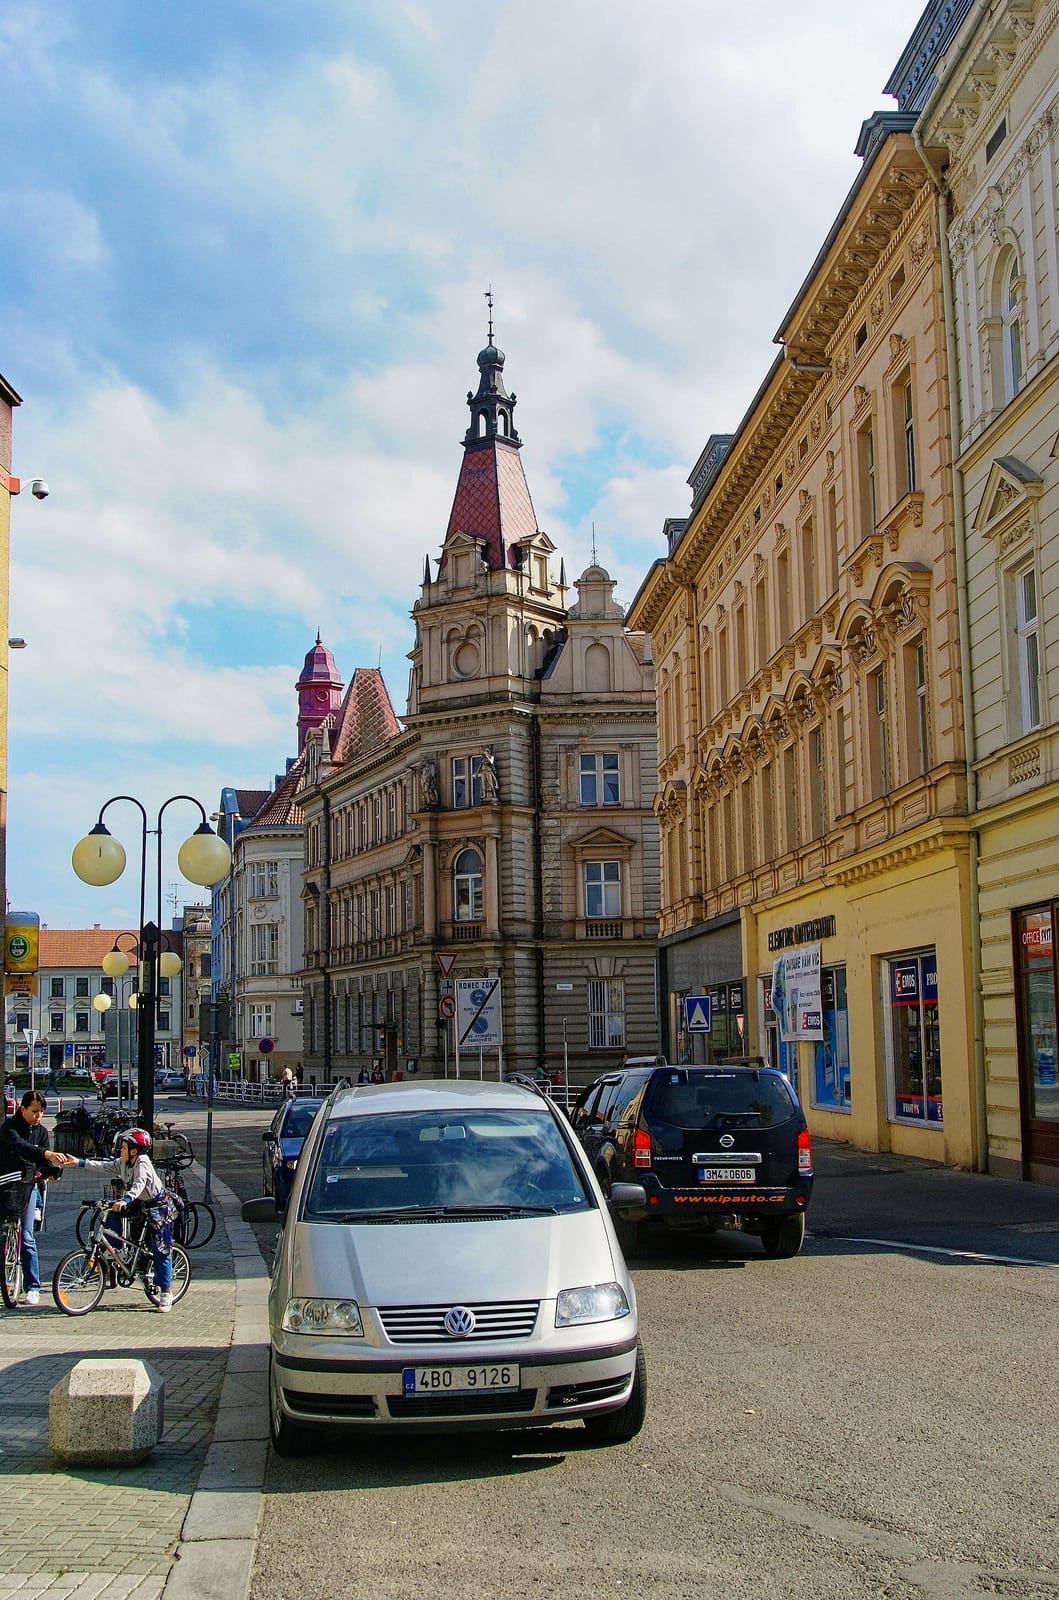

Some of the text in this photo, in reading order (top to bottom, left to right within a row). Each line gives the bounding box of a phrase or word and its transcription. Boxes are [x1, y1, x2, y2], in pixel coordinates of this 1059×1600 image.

[1022, 931, 1040, 945] OFFICE
[902, 974, 915, 988] EMOS
[807, 1015, 820, 1026] EMOS
[706, 1170, 752, 1180] 3M4 0606
[673, 1194, 785, 1204] www.ipauto.cz
[467, 1367, 511, 1387] 9126
